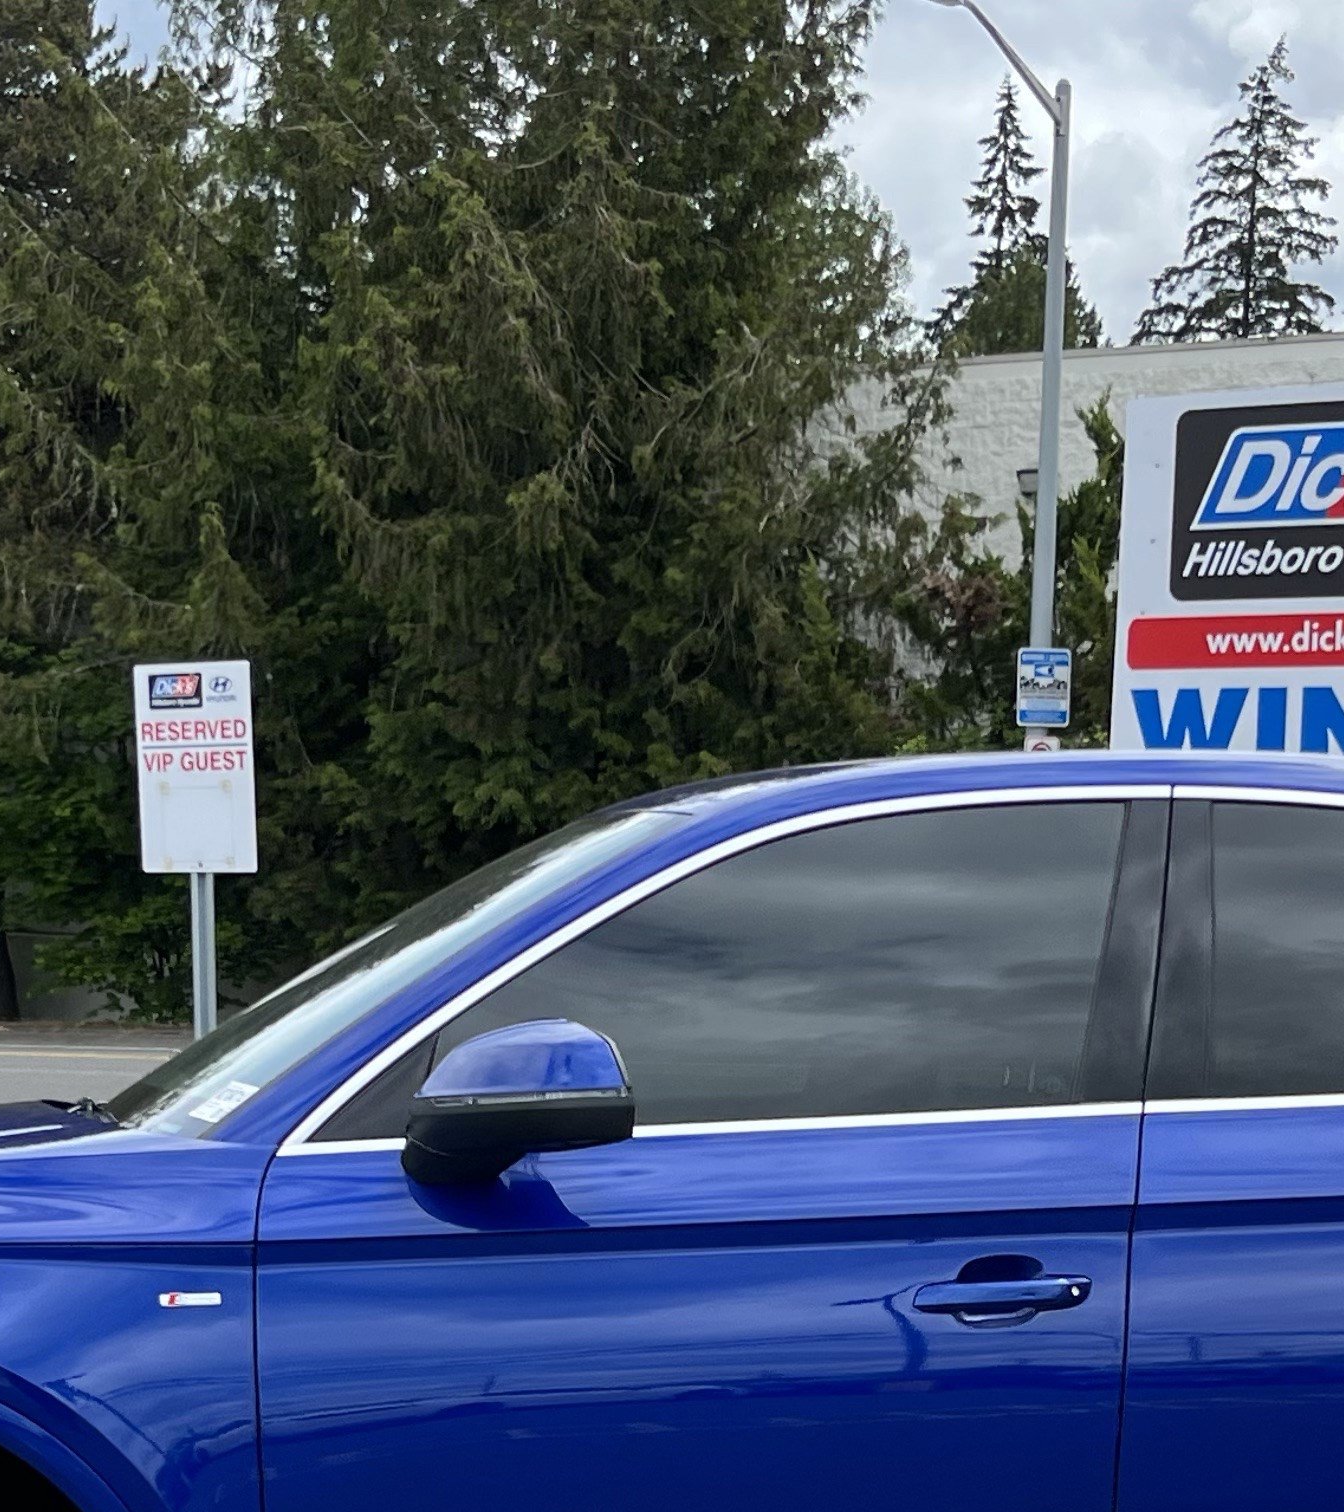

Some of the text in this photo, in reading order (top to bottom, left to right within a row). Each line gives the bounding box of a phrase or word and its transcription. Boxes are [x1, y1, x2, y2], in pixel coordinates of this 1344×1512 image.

[1181, 540, 1344, 578] Hillsboro
[141, 719, 247, 742] RESERVED
[143, 750, 247, 773] VIP GUEST
